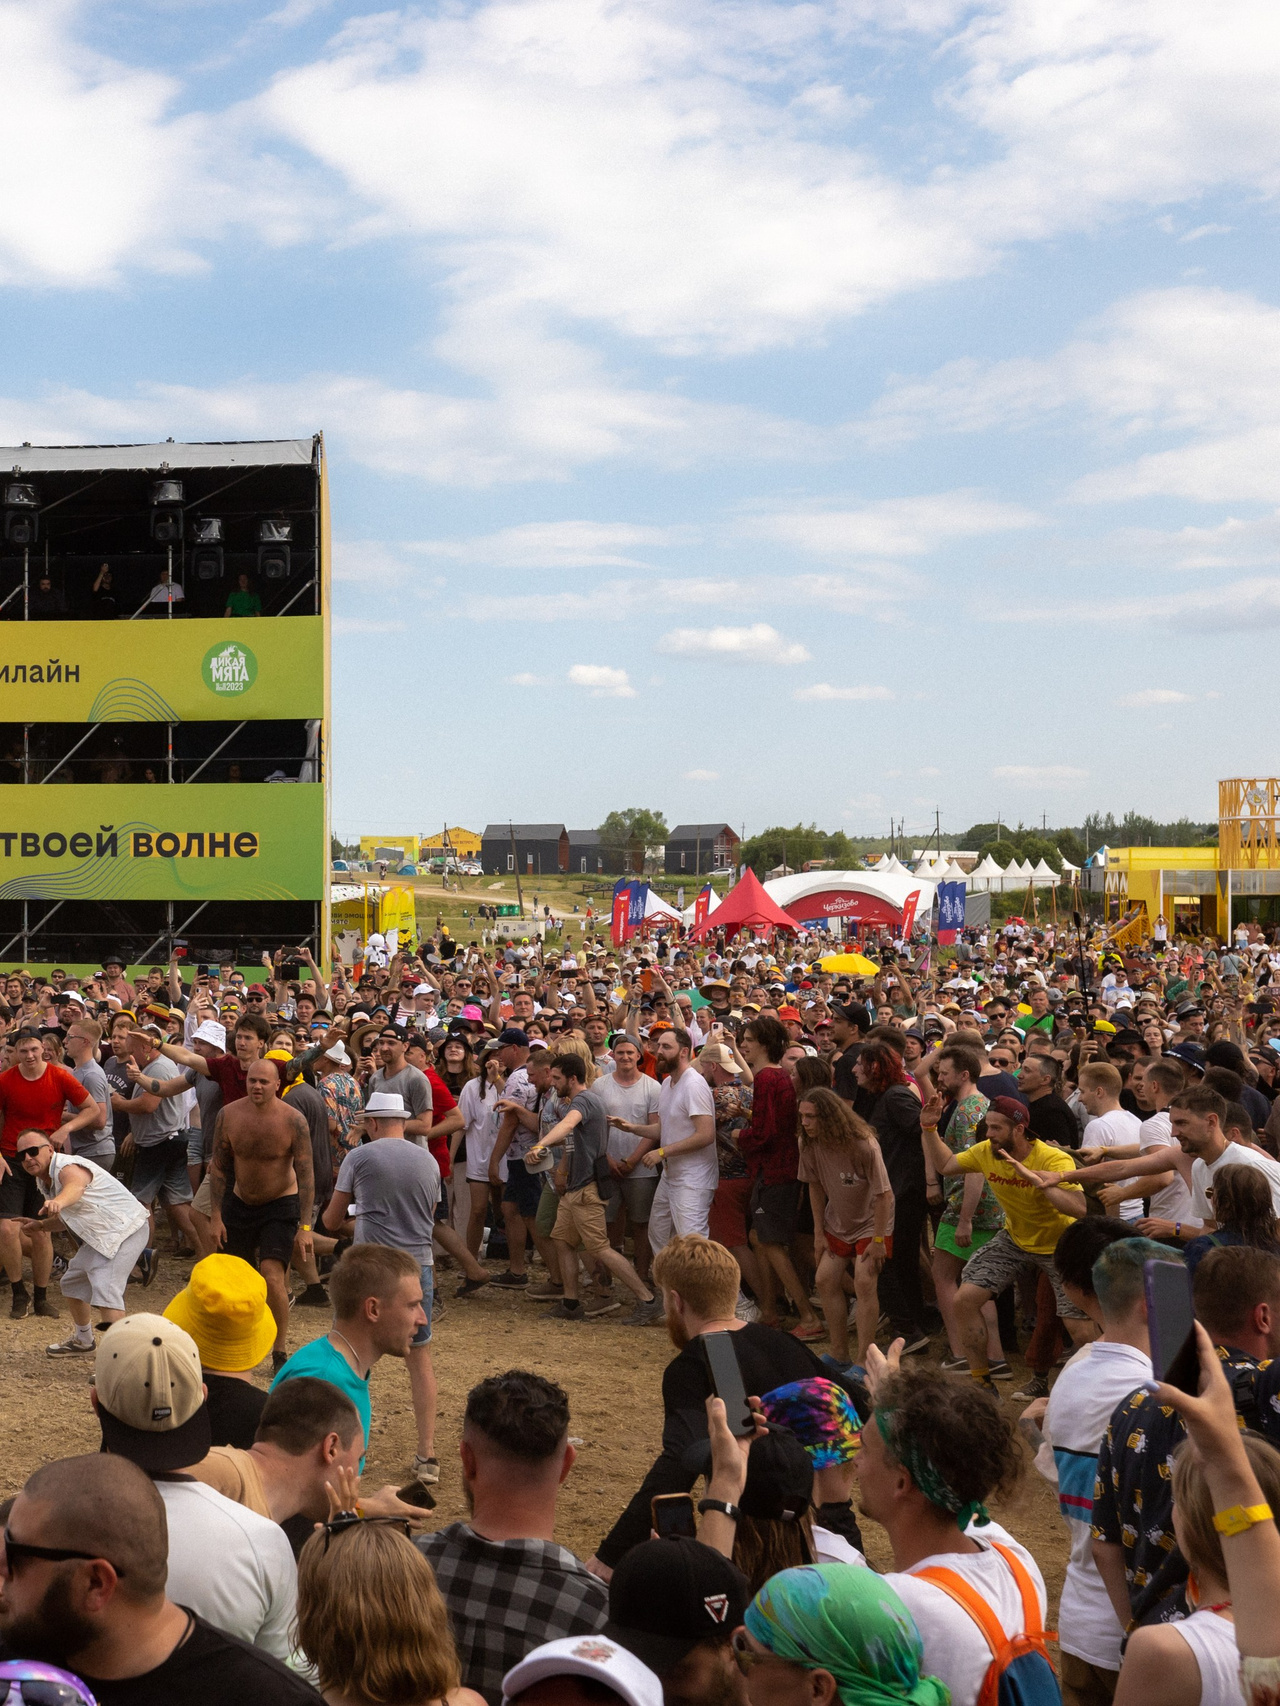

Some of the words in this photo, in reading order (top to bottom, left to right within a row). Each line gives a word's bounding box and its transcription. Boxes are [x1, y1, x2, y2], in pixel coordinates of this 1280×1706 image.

[210, 657, 246, 668] ДИКАЯ
[212, 666, 249, 682] МЯТА
[226, 683, 244, 691] 2023
[132, 831, 258, 858] волне
[823, 899, 859, 912] Черкизово
